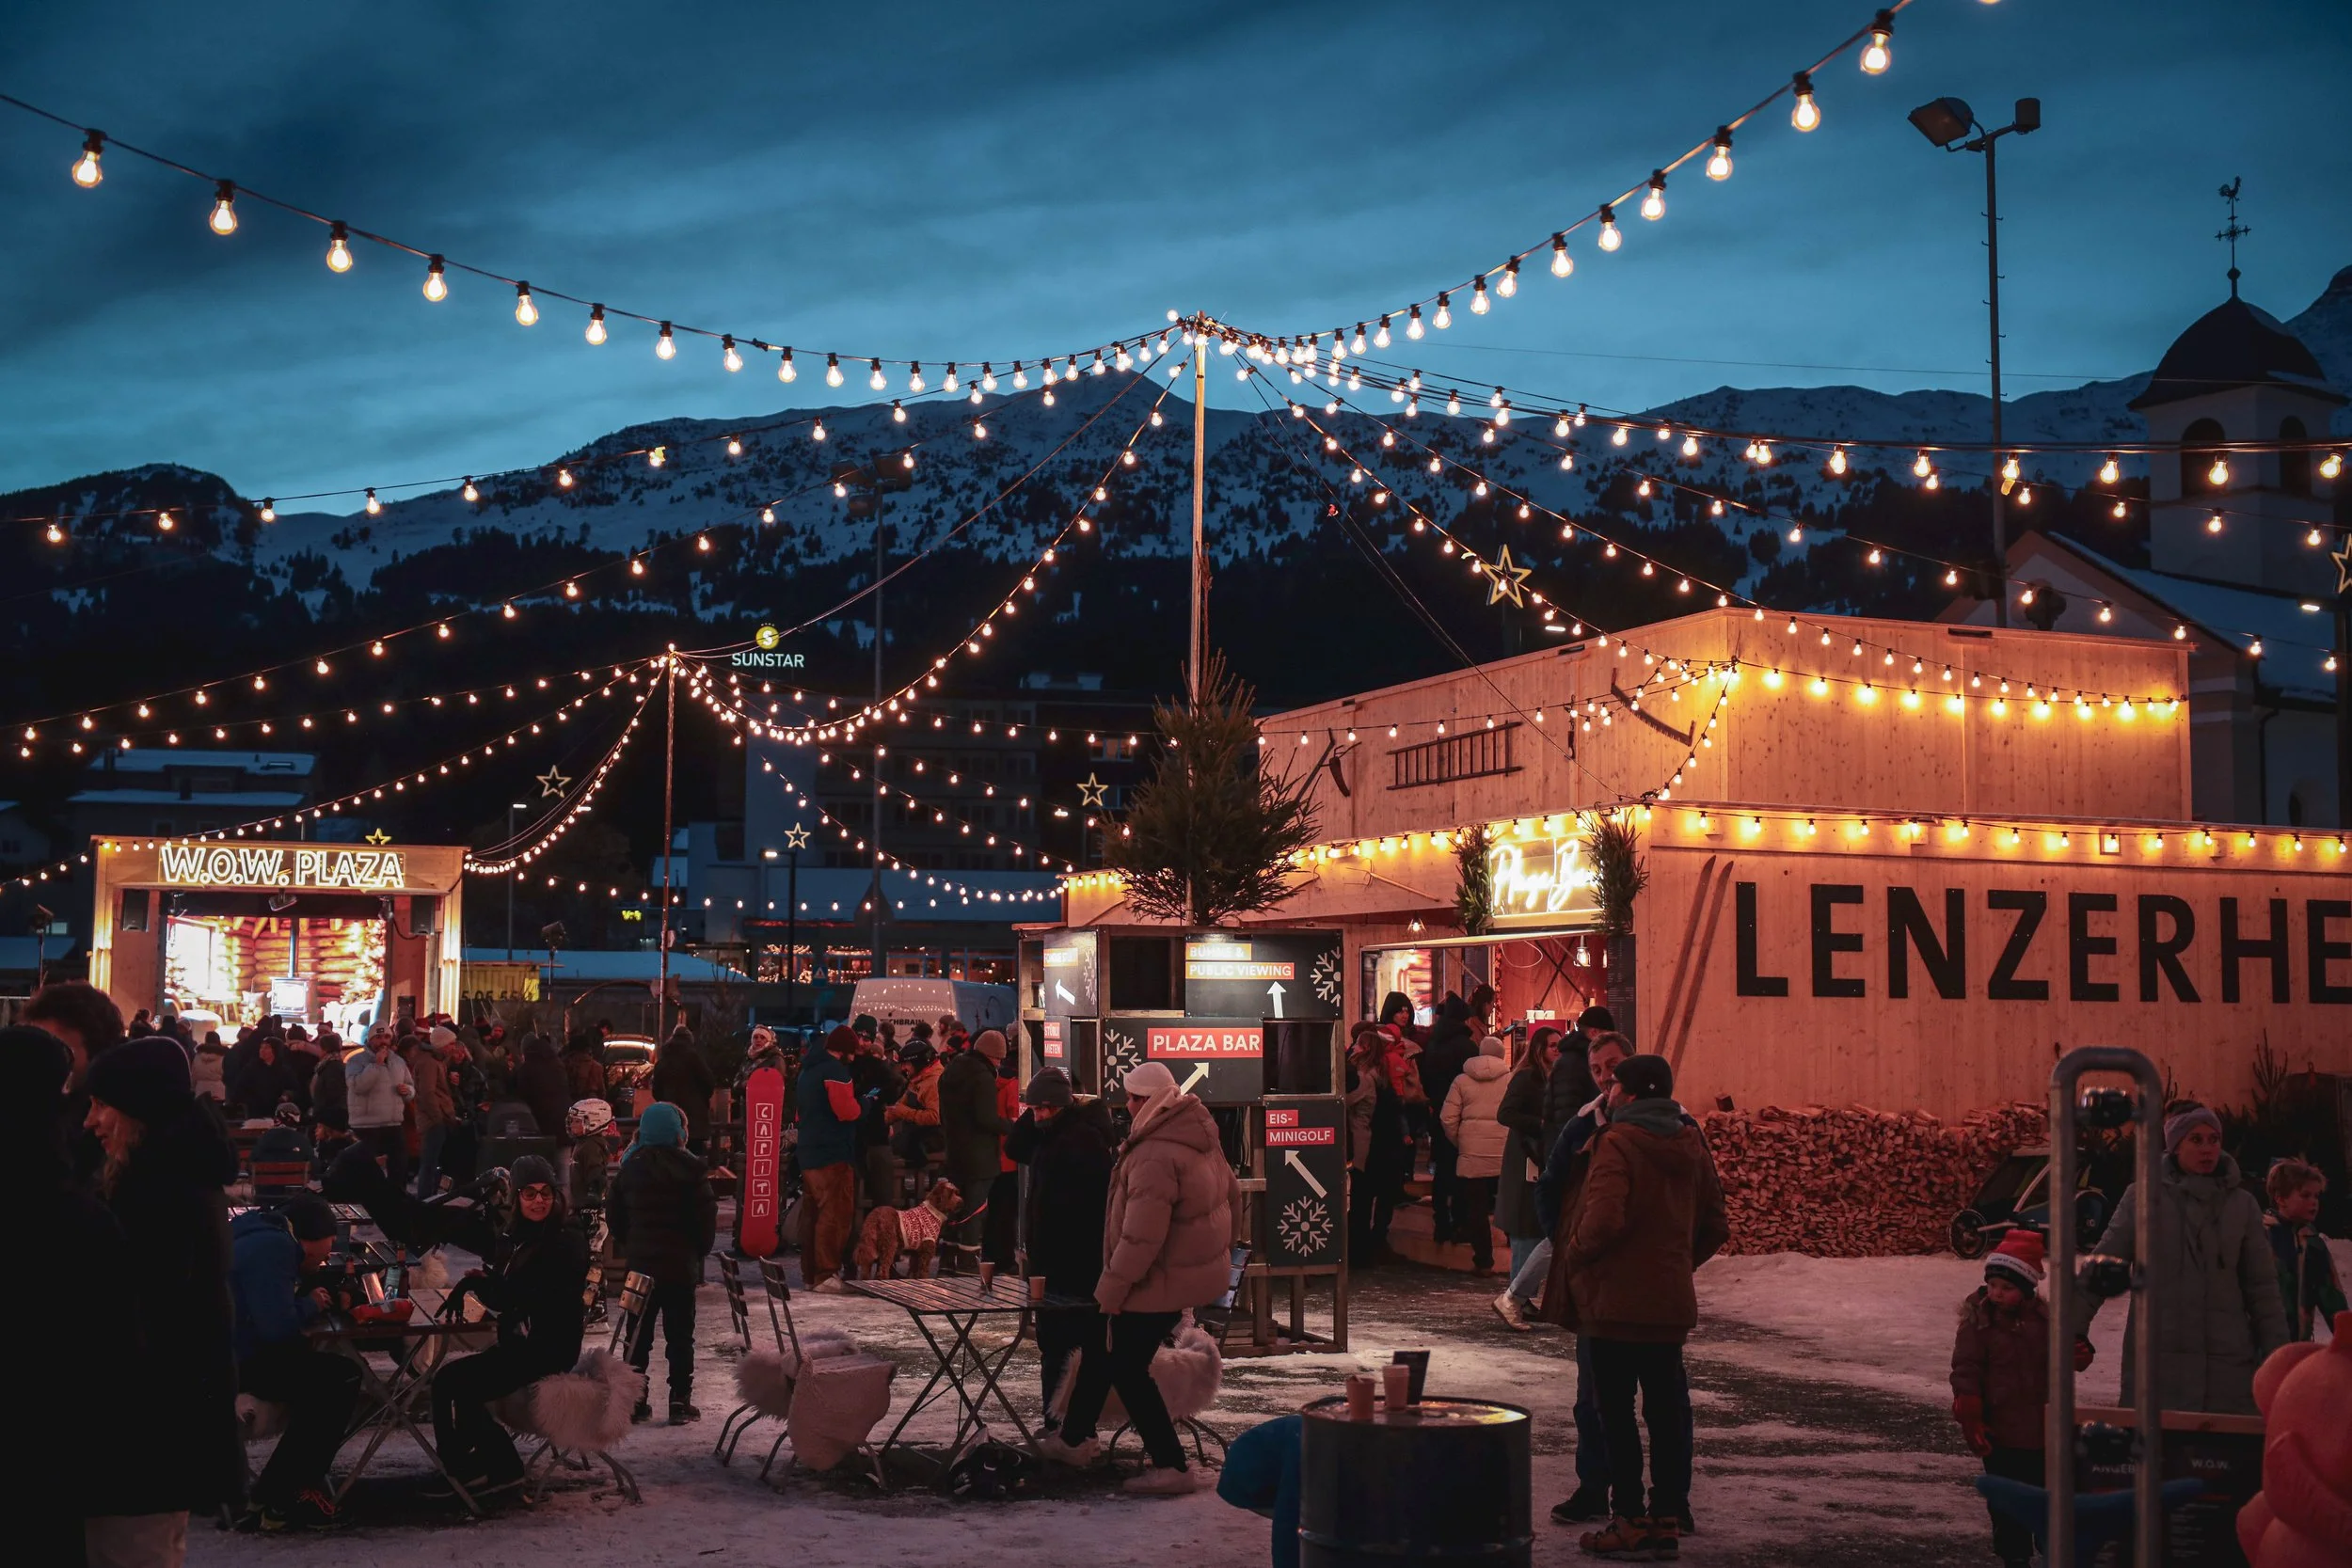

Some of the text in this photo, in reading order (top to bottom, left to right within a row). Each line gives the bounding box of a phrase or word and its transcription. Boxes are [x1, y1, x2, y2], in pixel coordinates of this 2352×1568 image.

[732, 653, 804, 668] SUNSTAR
[161, 847, 405, 888] W.O.W. PLAZA
[1736, 880, 2352, 1004] LENZERHE
[1189, 964, 1292, 976] PUBLIC VIEWING
[1153, 1034, 1261, 1052] PLAZA BAR
[1269, 1114, 1293, 1124] EIS-
[1269, 1131, 1330, 1142] MINIGOLF
